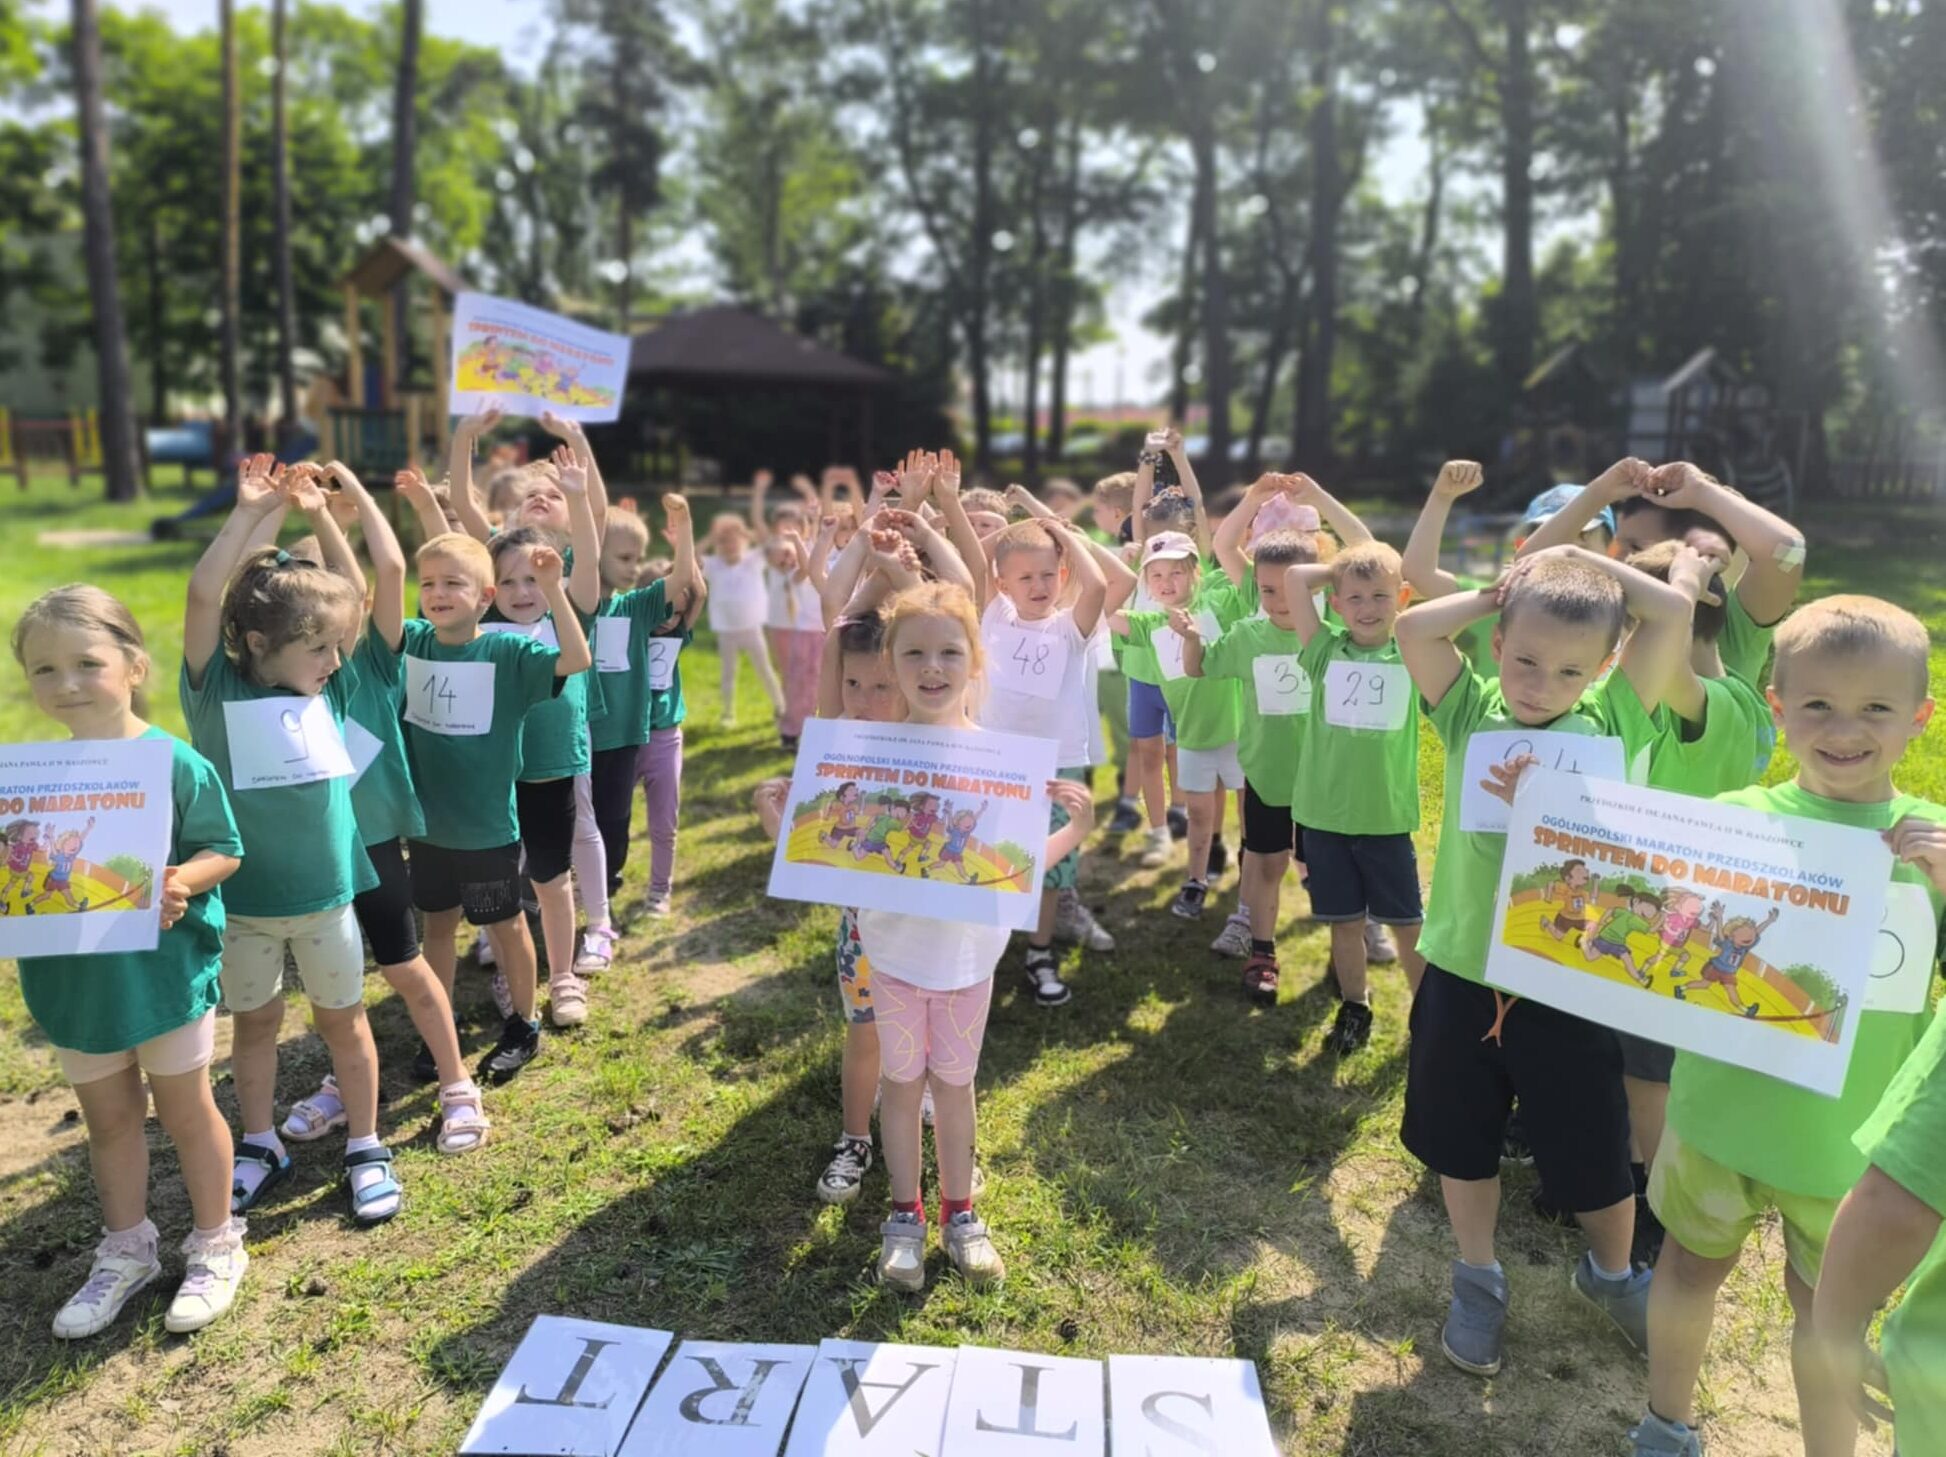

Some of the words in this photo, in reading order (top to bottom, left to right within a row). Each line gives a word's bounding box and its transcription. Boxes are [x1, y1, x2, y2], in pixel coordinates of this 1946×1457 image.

[1012, 637, 1050, 676] 48
[422, 674, 457, 714] 14
[1342, 671, 1385, 706] 29
[280, 709, 310, 764] 9
[815, 762, 900, 784] SPRINTEM
[902, 769, 929, 787] DO
[931, 772, 1032, 801] MARATONU
[824, 752, 890, 765] OGÓLNOPOLSKI
[892, 758, 938, 770] MARATON
[940, 761, 1028, 781] PRZEDSZKOLAKÓW
[29, 792, 146, 814] MARATONU
[37, 780, 140, 793] PRZEDSZKOLAKÓW
[1660, 813, 1685, 825] JANA
[1533, 825, 1648, 872] SPRINTEM
[1650, 853, 1690, 881] DO
[1693, 862, 1851, 917] MARATONU
[1541, 814, 1633, 843] OGÓLNOPOLSKI
[1635, 836, 1703, 860] MARATON
[1706, 851, 1845, 889] PRZEDSZKOLAKÓW
